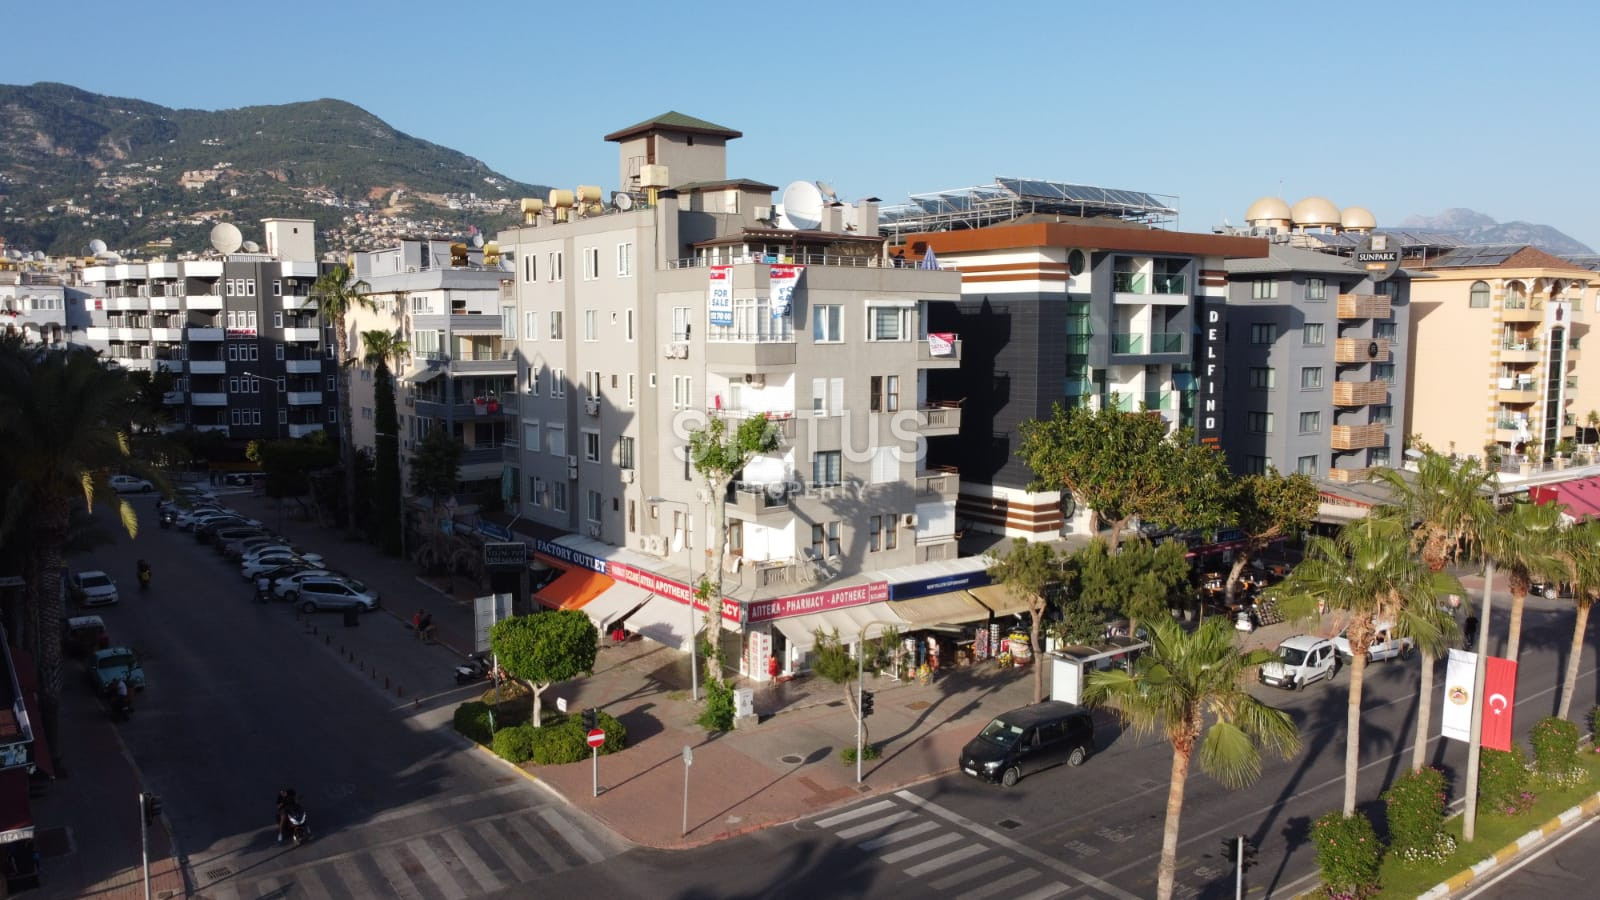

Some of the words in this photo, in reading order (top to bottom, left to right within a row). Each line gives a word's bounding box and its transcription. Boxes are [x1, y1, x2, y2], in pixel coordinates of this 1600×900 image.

[1359, 253, 1395, 261] SUNPARK
[711, 299, 729, 307] SALE
[713, 289, 728, 297] FOR
[1205, 310, 1219, 429] DELFINO
[537, 539, 573, 561] FACTORY
[573, 552, 606, 573] OUTLET
[655, 580, 690, 601] APOTHEKE
[786, 595, 825, 611] PHARMACY
[831, 588, 866, 604] APOTHEKE
